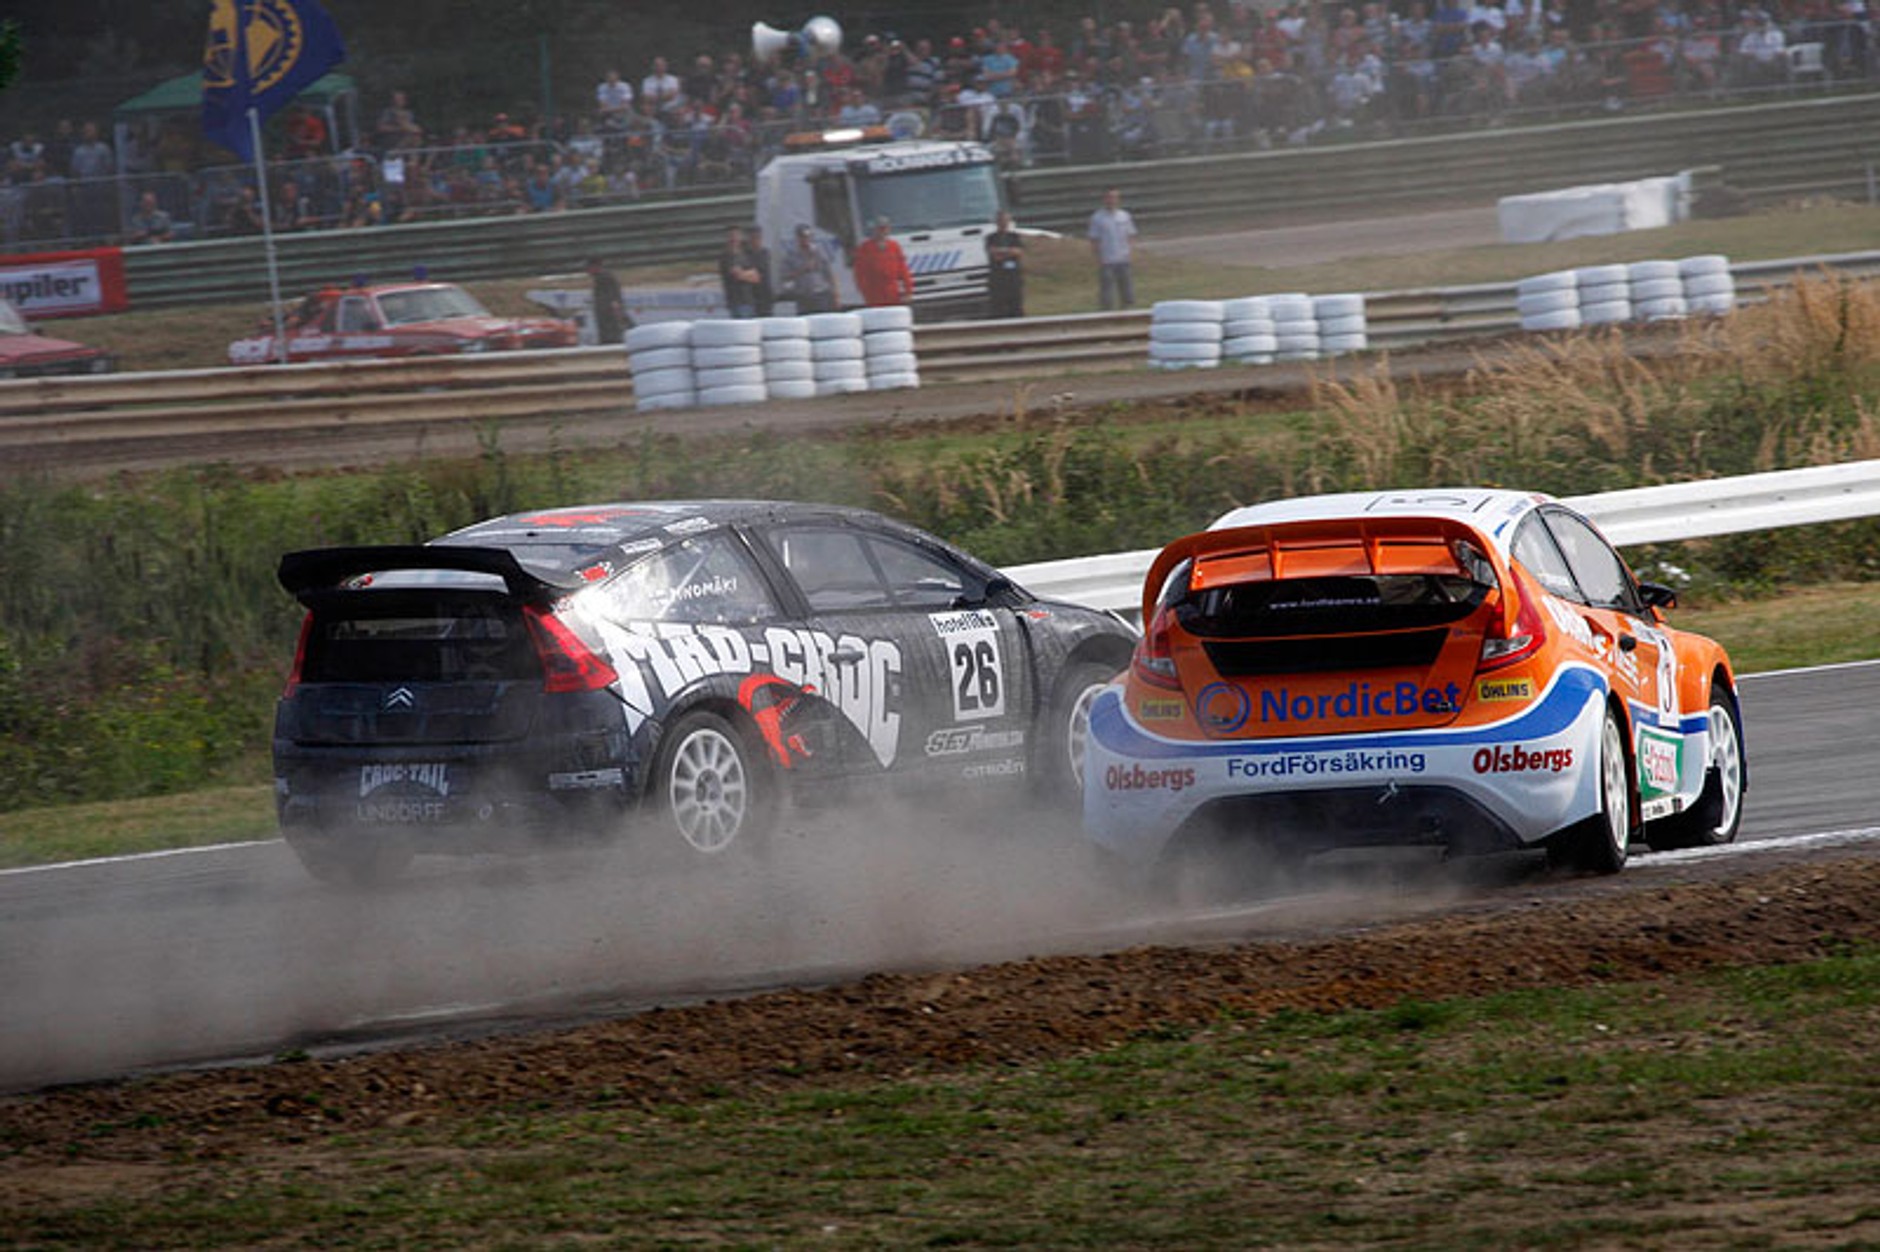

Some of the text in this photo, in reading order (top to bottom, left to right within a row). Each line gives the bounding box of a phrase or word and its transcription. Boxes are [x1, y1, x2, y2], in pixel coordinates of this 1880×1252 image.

[954, 640, 999, 711] 26
[602, 621, 901, 769] MAD-CROC
[1260, 682, 1461, 722] NordicBet
[1105, 763, 1196, 790] Olsbergs
[1227, 750, 1426, 778] FordFörsäkring
[1473, 744, 1573, 775] Olsbergs
